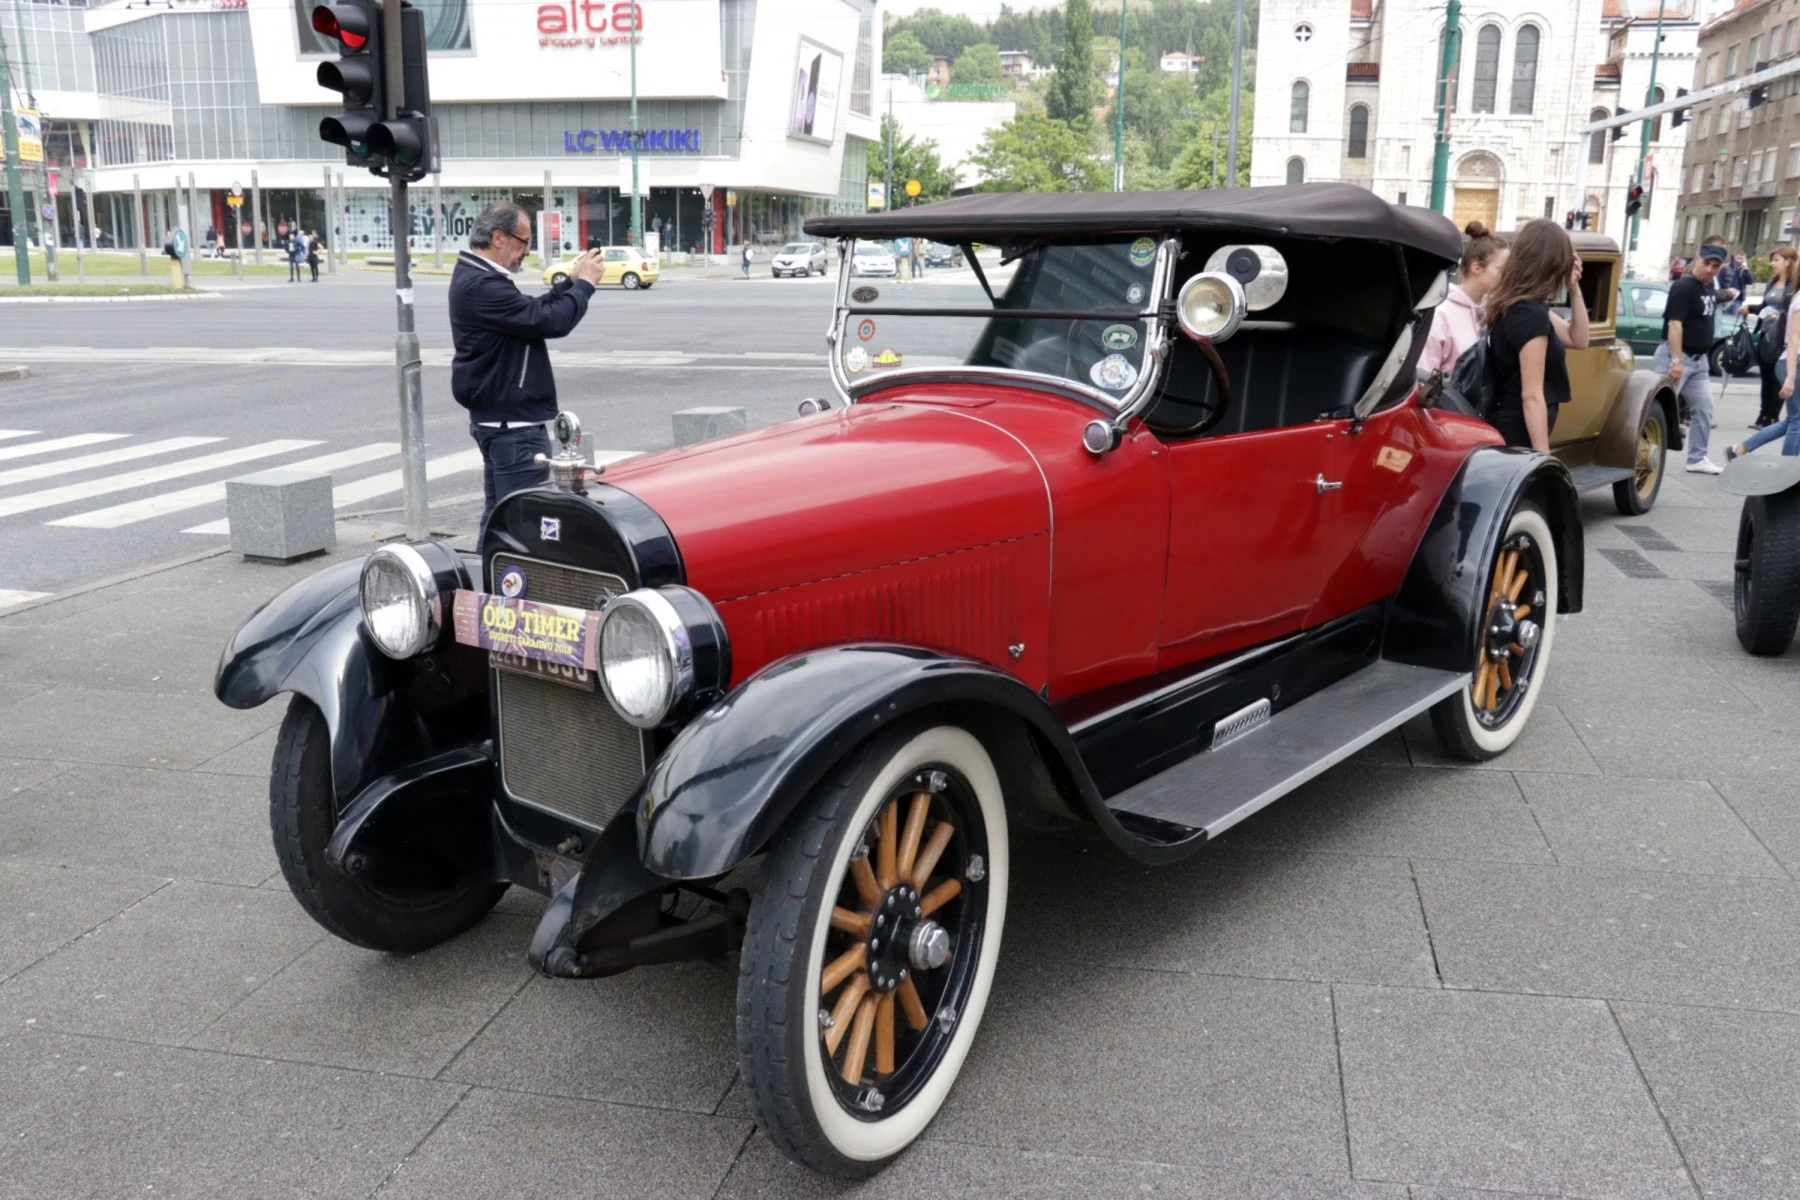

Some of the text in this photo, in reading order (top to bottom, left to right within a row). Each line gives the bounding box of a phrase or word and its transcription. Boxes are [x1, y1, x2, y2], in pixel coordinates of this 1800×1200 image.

[537, 0, 643, 33] alta
[539, 37, 596, 48] shopping
[564, 129, 700, 152] LC WAIKIKI
[483, 605, 517, 631] OLD
[521, 610, 580, 642] TIMER
[488, 631, 517, 644] SUSRETI
